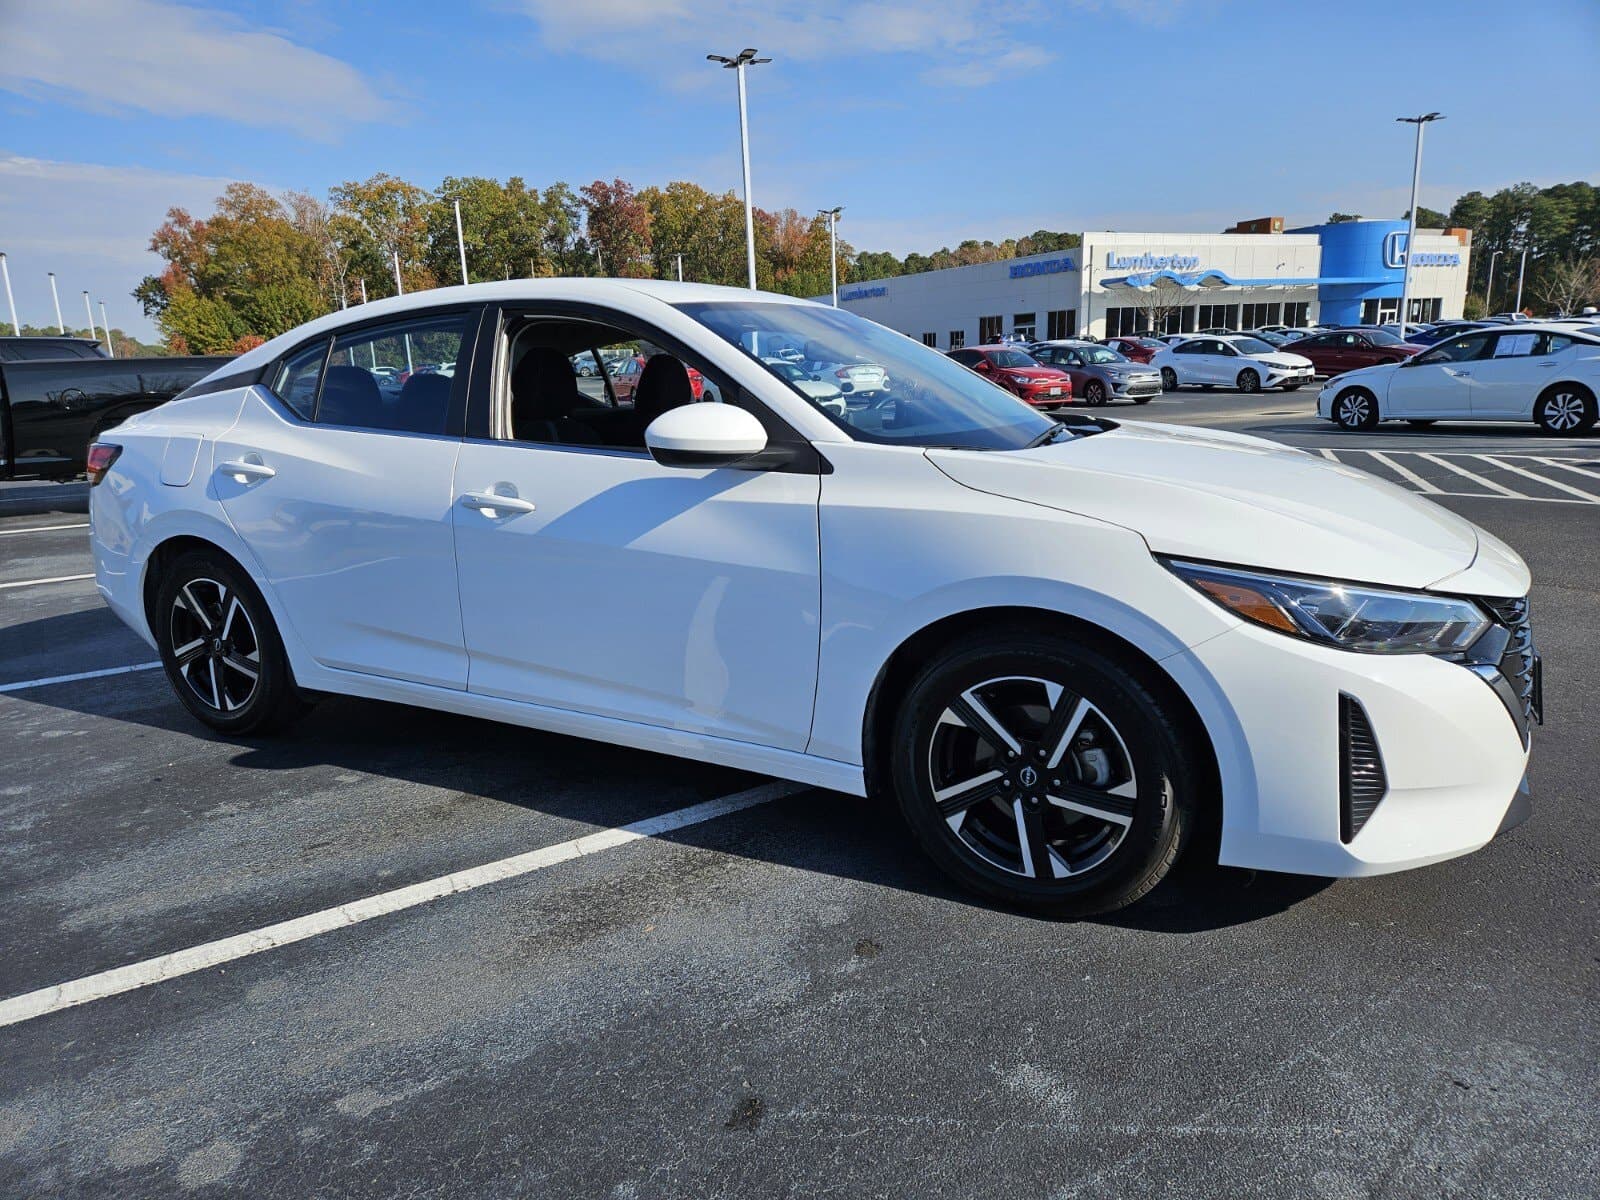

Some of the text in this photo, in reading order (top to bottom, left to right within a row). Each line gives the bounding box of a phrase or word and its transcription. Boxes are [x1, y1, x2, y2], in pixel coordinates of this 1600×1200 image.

[1009, 258, 1075, 279] HONDA
[1106, 250, 1200, 270] Lumberton
[840, 286, 889, 301] Lumberton
